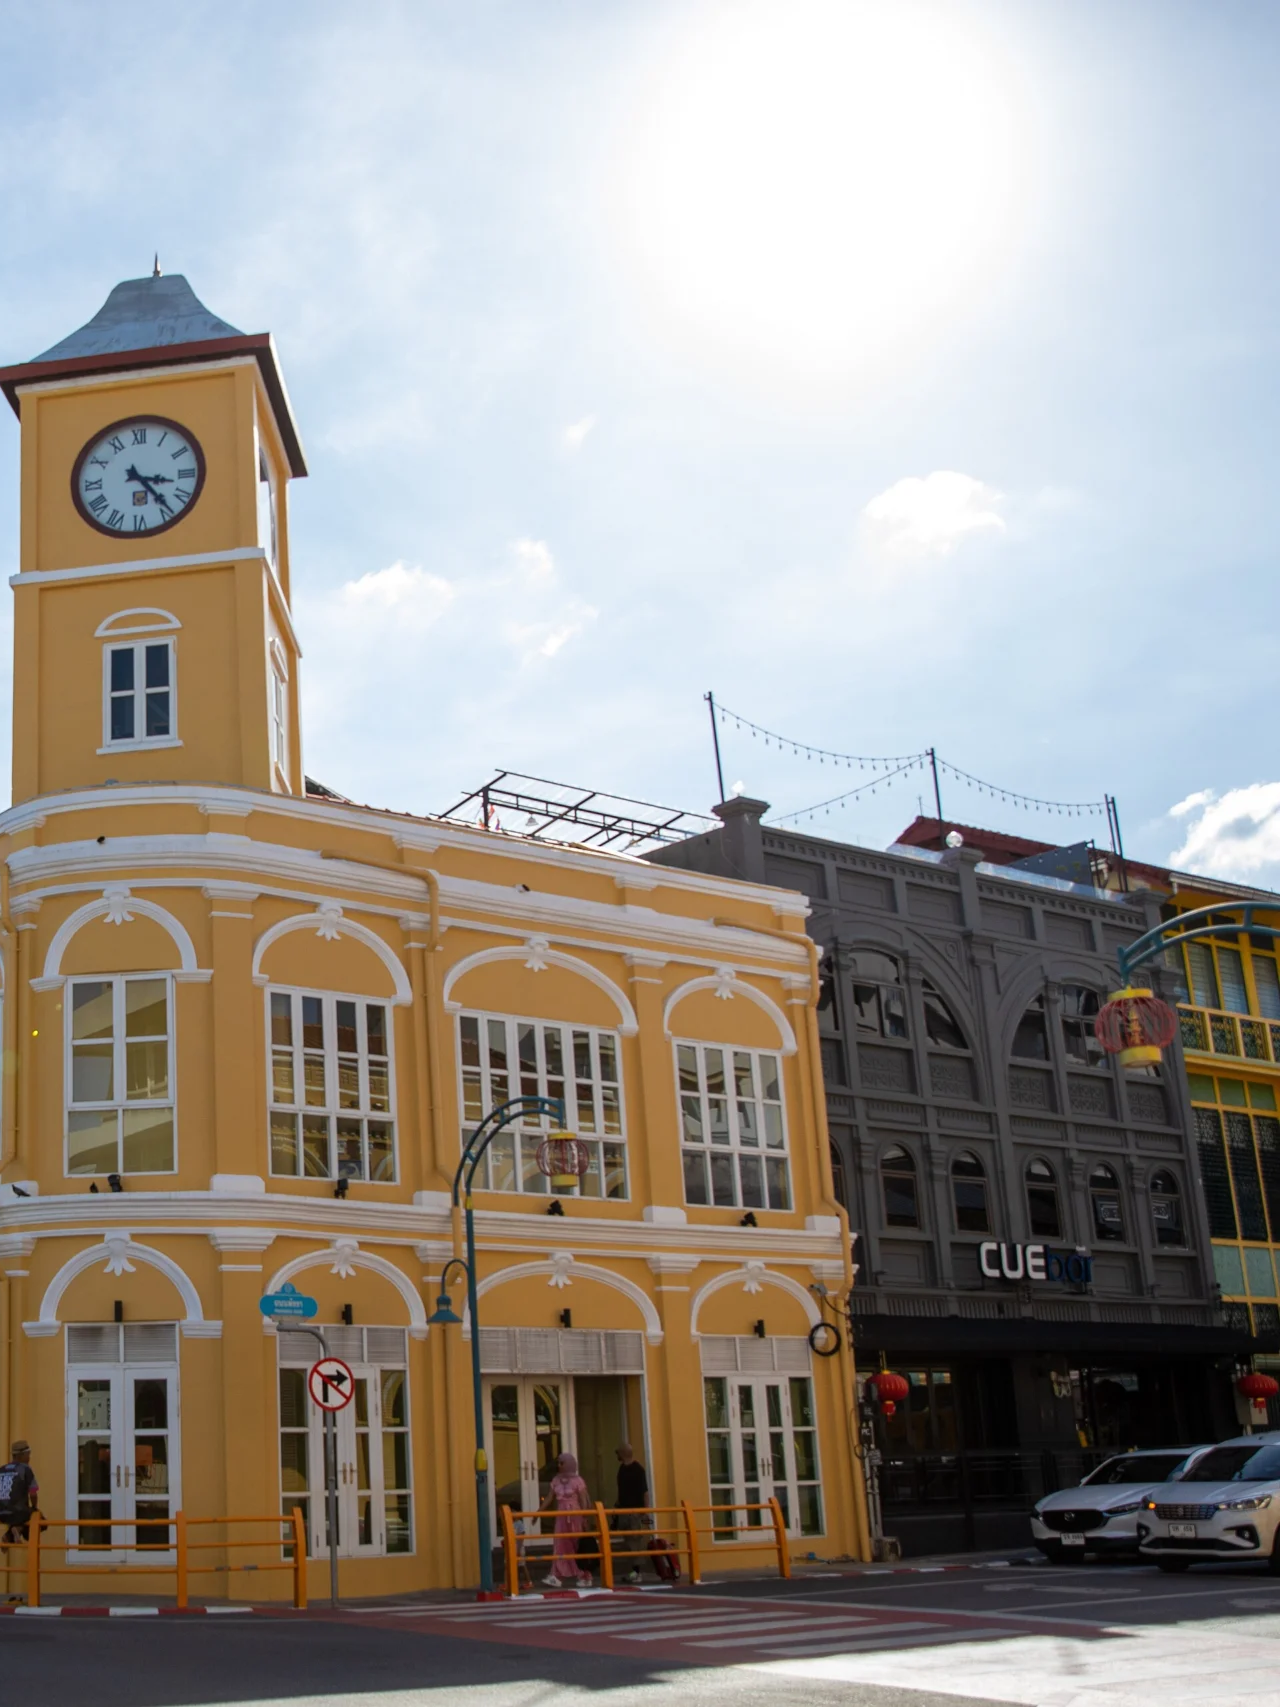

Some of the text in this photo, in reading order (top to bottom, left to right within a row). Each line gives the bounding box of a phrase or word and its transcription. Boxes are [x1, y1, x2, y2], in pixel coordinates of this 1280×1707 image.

[108, 435, 126, 455] XI
[131, 428, 147, 446] XII
[171, 445, 189, 460] II
[90, 456, 108, 469] X
[178, 468, 196, 480] III
[85, 478, 102, 492] IX
[173, 487, 192, 505] IV
[88, 493, 110, 518] VIII
[106, 508, 125, 531] VII
[132, 514, 148, 532] VI
